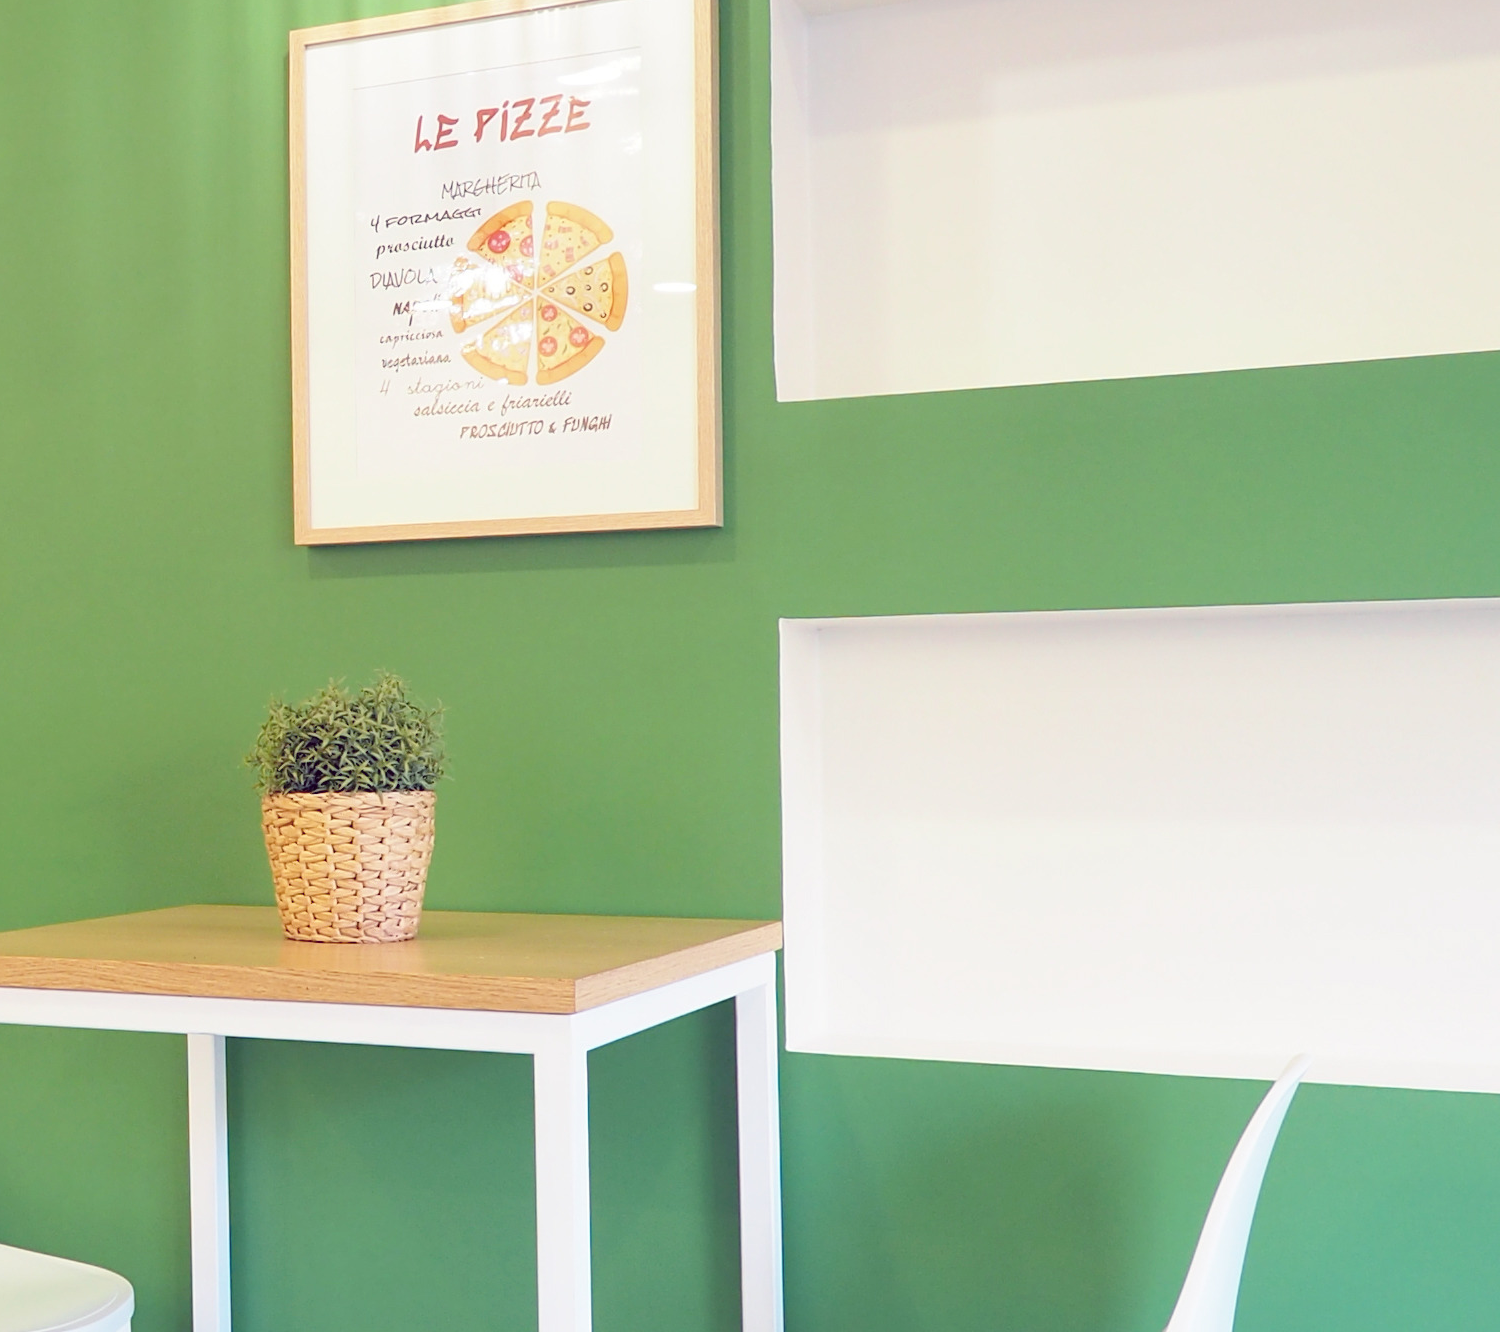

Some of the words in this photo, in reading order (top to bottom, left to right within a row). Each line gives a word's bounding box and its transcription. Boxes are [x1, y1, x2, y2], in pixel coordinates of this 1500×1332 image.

[414, 114, 459, 153] LE
[441, 171, 542, 200] MARGHERITA
[370, 215, 380, 233] 4
[385, 207, 481, 228] FORMAGGI
[376, 234, 455, 259] prosciutto
[379, 330, 444, 349] capricciosa
[381, 350, 452, 373] vegetariana
[407, 377, 485, 400] stagioni
[413, 395, 480, 417] salsiccia
[487, 399, 496, 411] e
[501, 390, 573, 416] friarielli
[460, 419, 544, 439] PROSCIUTTO
[563, 414, 613, 433] FUNGHI
